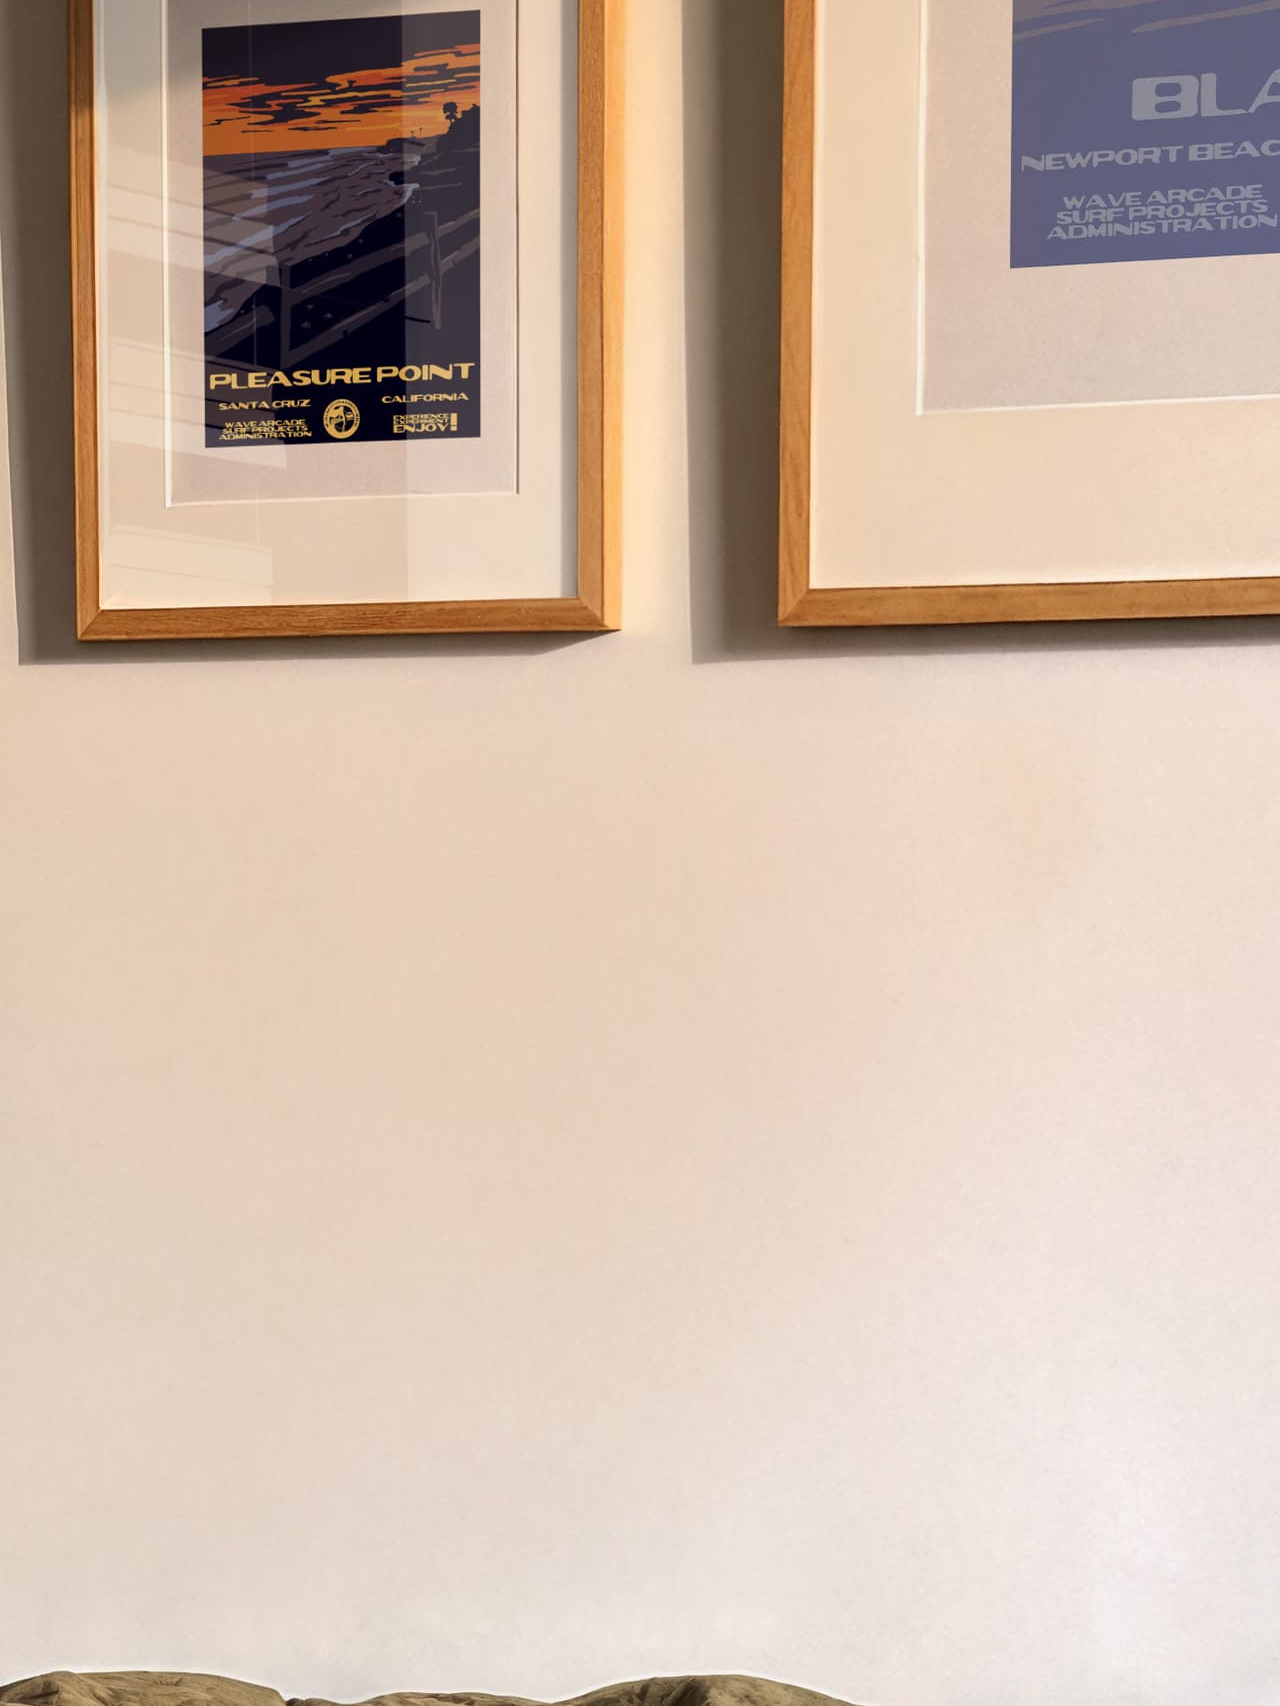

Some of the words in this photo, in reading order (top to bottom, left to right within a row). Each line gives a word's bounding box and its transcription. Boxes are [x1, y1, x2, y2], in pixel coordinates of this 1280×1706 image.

[1021, 145, 1184, 173] NEWPORT
[1062, 192, 1142, 209] WAVE
[1146, 184, 1263, 205] ARCADE
[1056, 208, 1124, 224] SURF
[1128, 199, 1269, 221] PROJECTS
[1046, 213, 1279, 242] ADMINISTRATION
[209, 367, 371, 390] PLEASURE
[376, 362, 476, 383] POINT
[219, 400, 270, 410] SANTA
[271, 398, 312, 409] CRUZ
[381, 392, 469, 404] CALIFORNIA
[219, 430, 313, 441] ADMINISTRATION
[224, 420, 257, 428] WAVE
[259, 418, 306, 427] ARCADE
